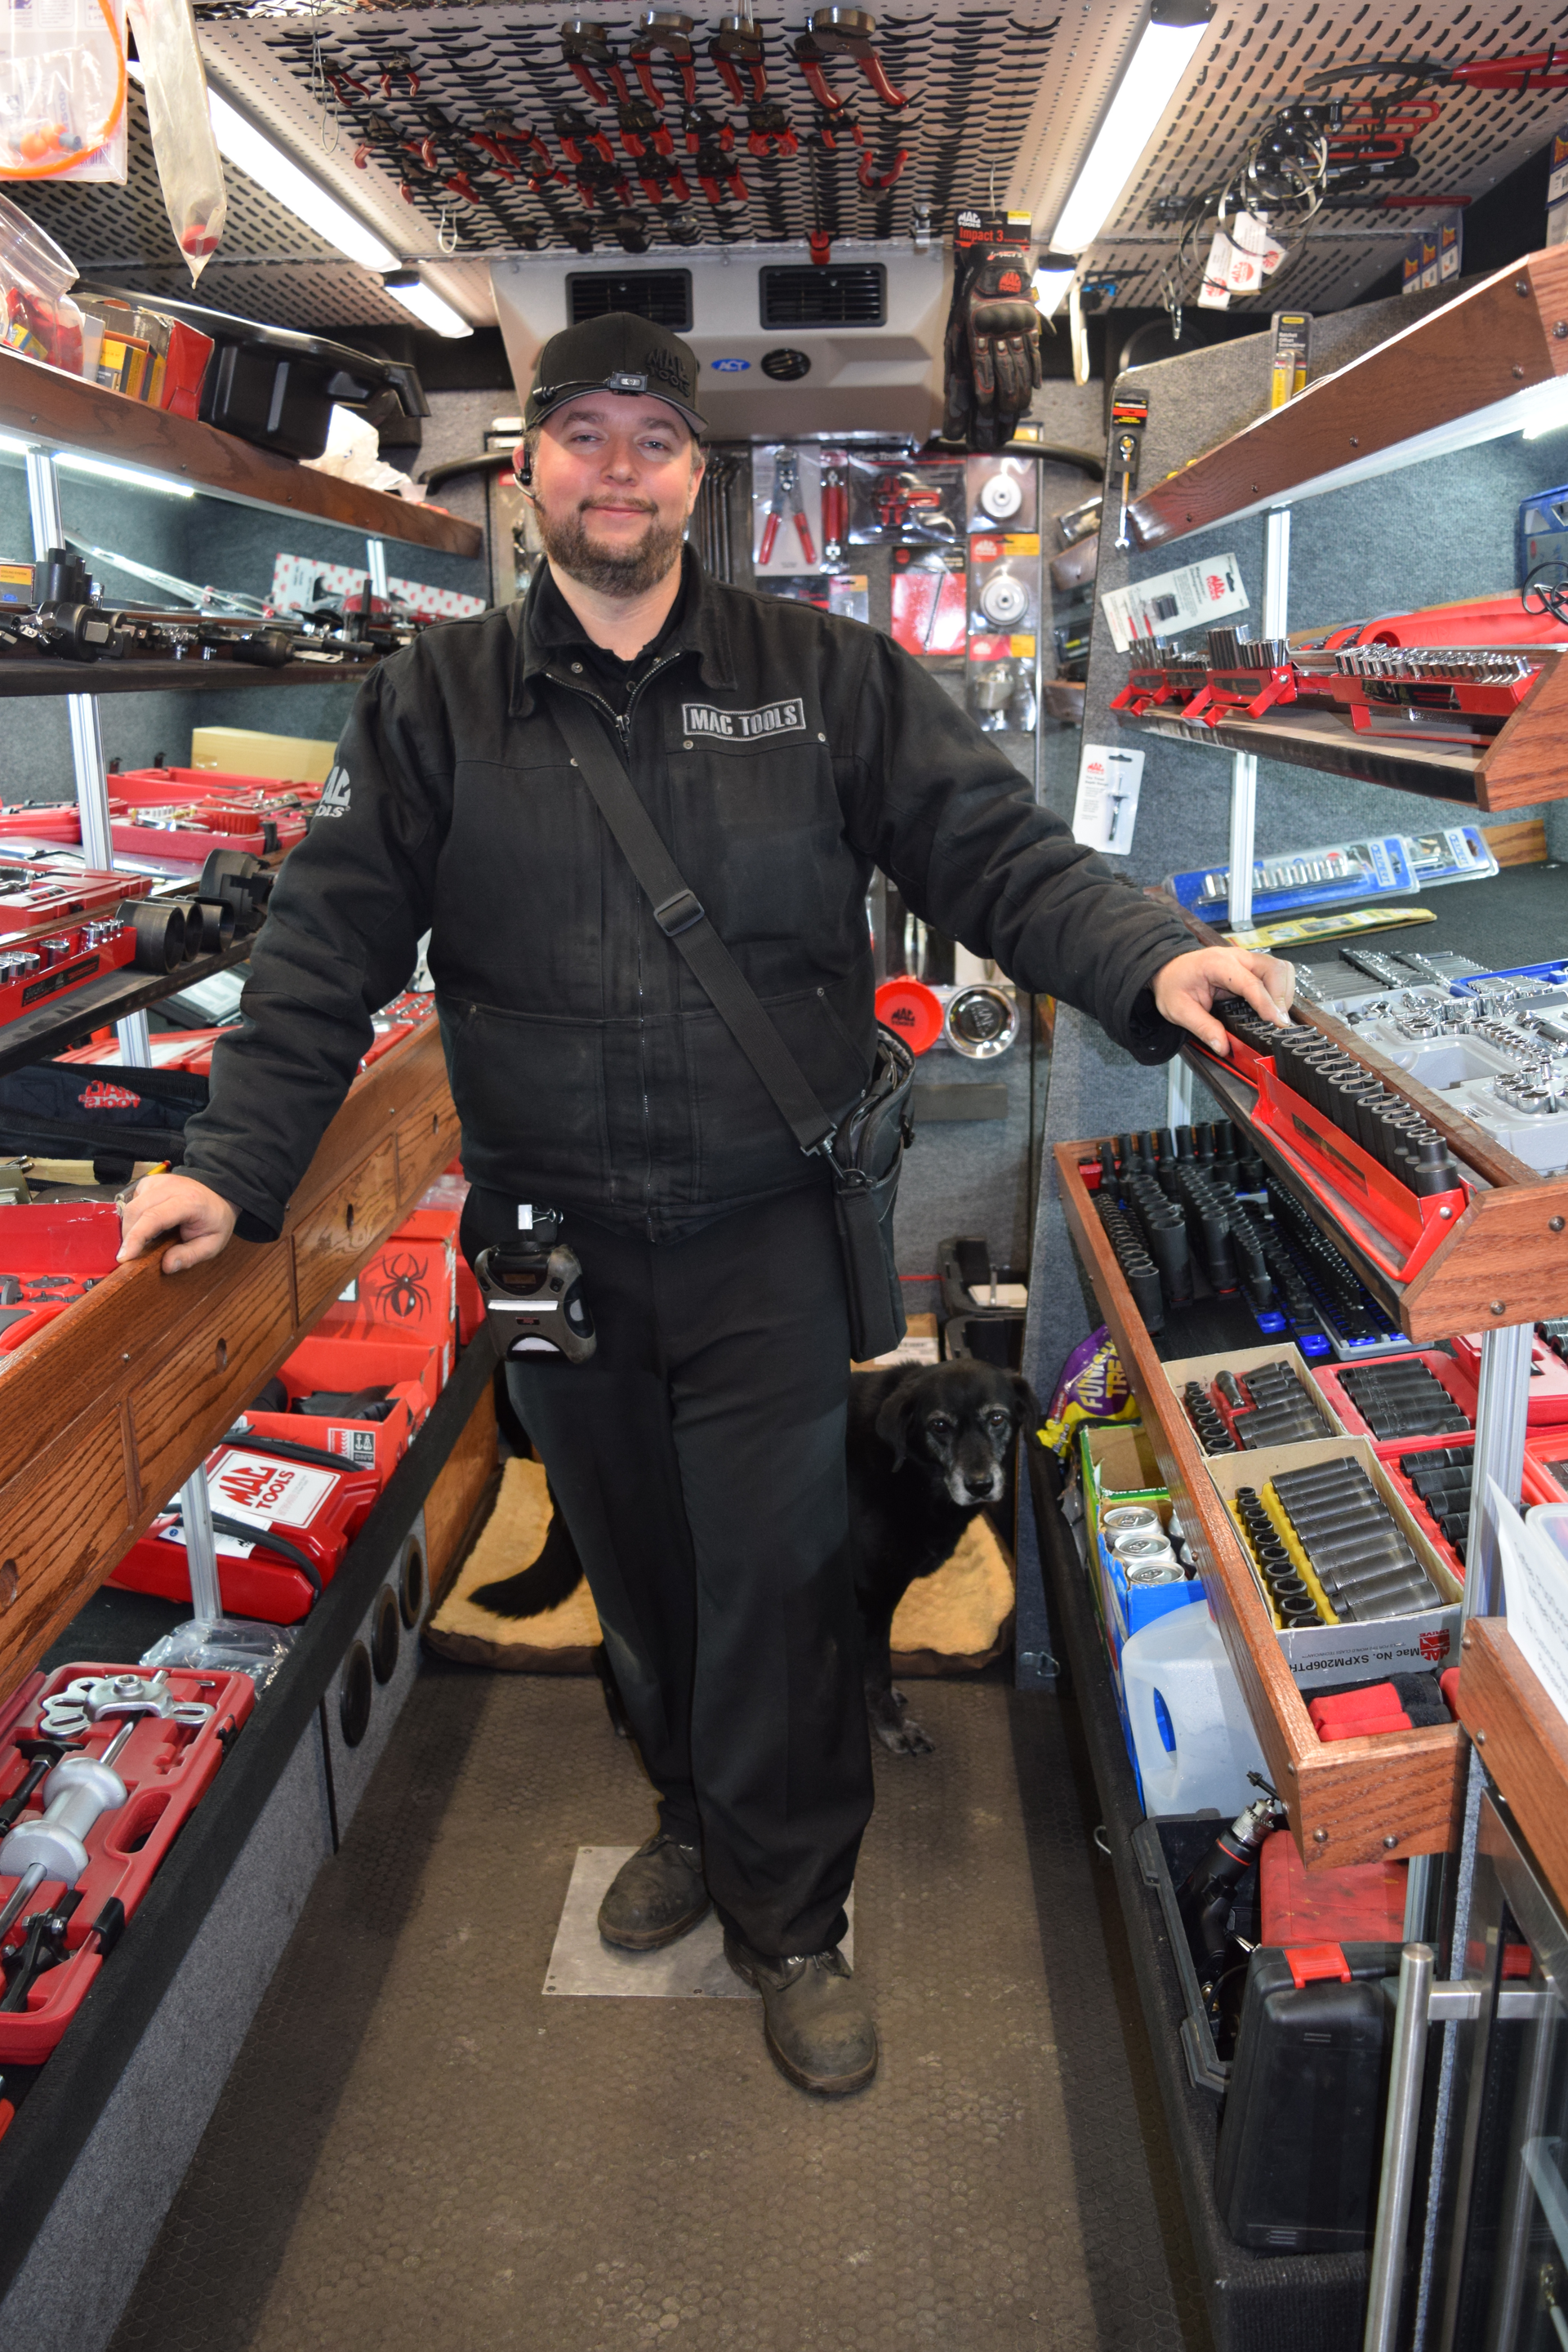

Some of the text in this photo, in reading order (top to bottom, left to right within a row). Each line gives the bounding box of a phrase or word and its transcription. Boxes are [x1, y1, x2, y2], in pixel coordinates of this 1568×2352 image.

[957, 211, 981, 223] MAC
[959, 227, 1004, 243] Impact 3
[1206, 576, 1216, 601] TOOLS
[1212, 575, 1226, 600] MAC
[690, 705, 797, 736] MAC TOOLS
[319, 766, 351, 807] AC
[315, 804, 345, 817] OLS
[891, 1007, 915, 1021] MAC
[219, 1467, 278, 1507] MAC
[255, 1470, 295, 1509] TOOLS
[1419, 1628, 1450, 1638] DRIVE
[1373, 1651, 1392, 1660] No.
[1396, 1647, 1419, 1657] Mac
[1420, 1647, 1450, 1661] MAC
